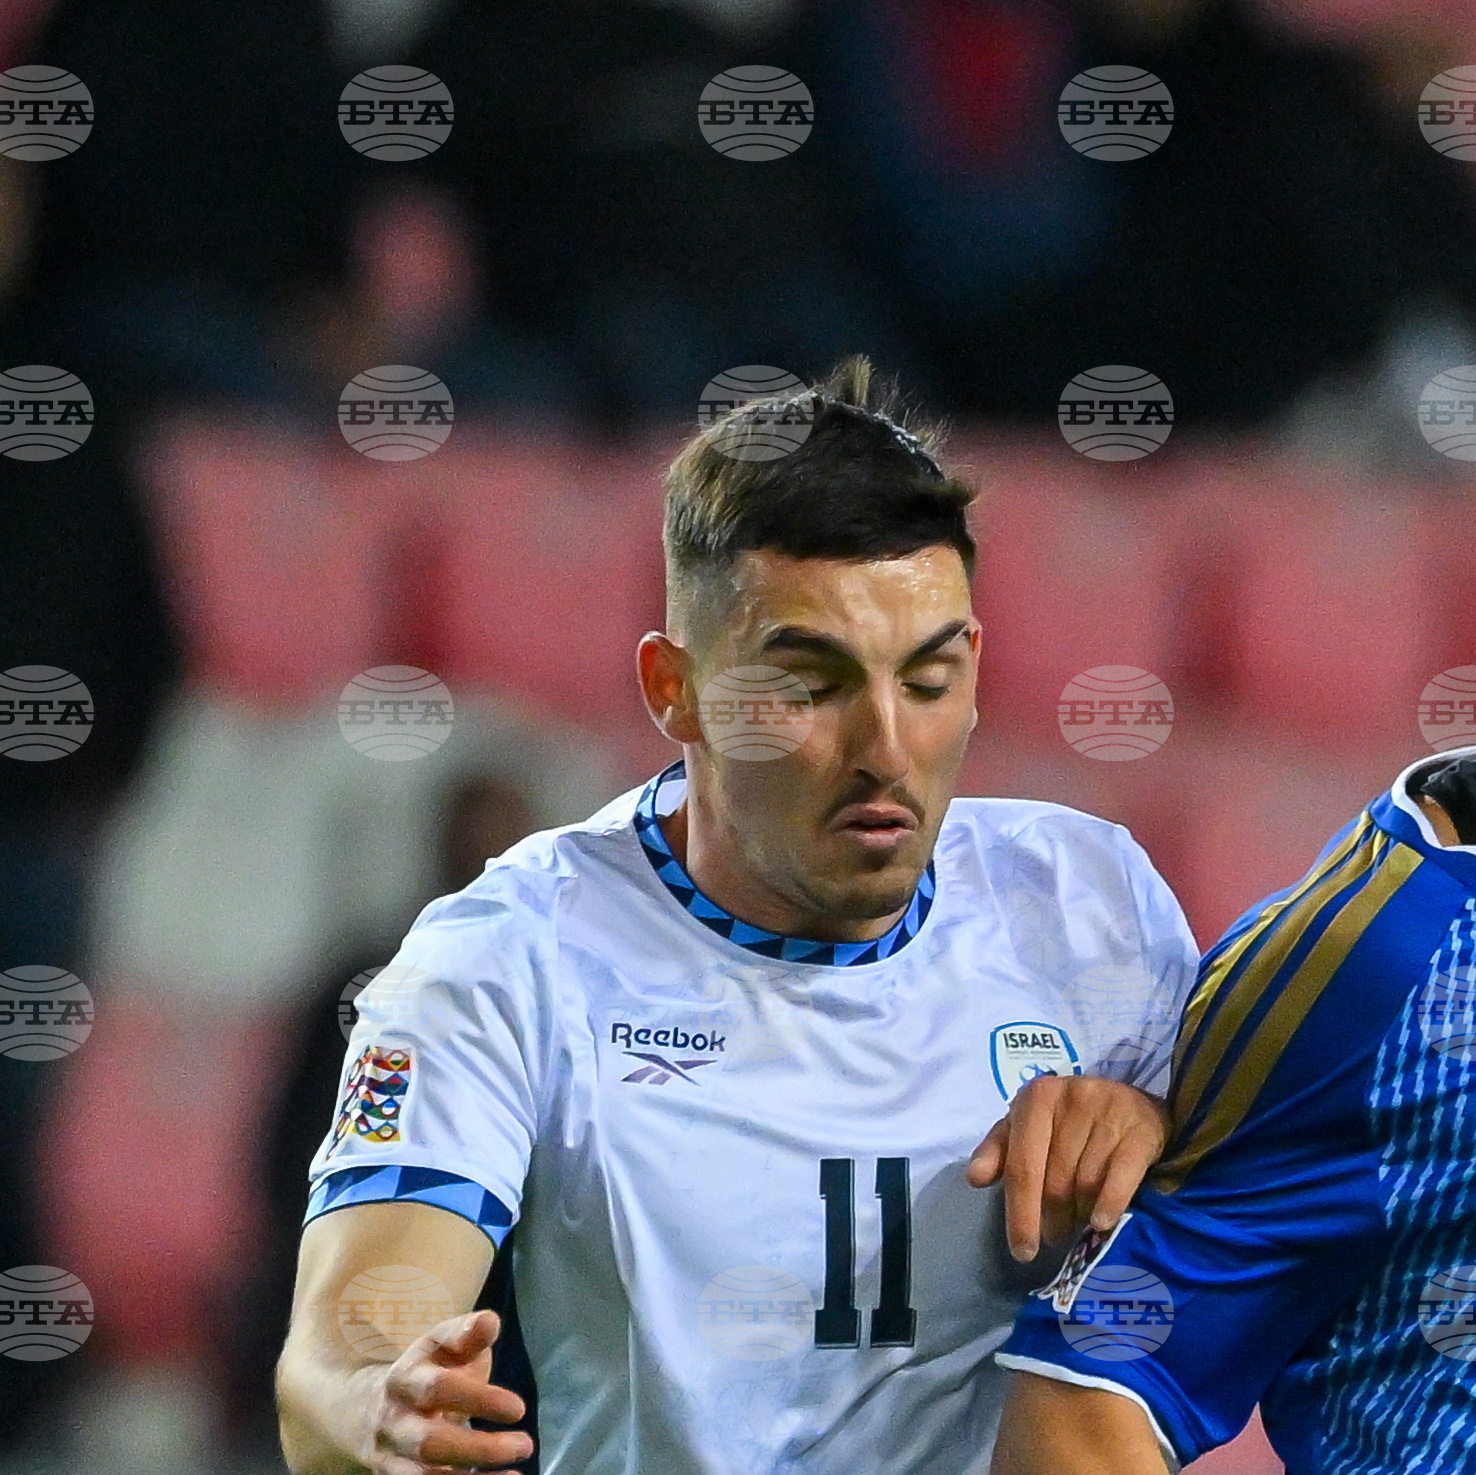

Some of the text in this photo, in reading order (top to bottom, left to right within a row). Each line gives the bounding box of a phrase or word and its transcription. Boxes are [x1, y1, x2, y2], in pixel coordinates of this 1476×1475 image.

[611, 1023, 726, 1052] Reebok
[1003, 1032, 1060, 1049] ISRAEL
[814, 1156, 917, 1349] 11
